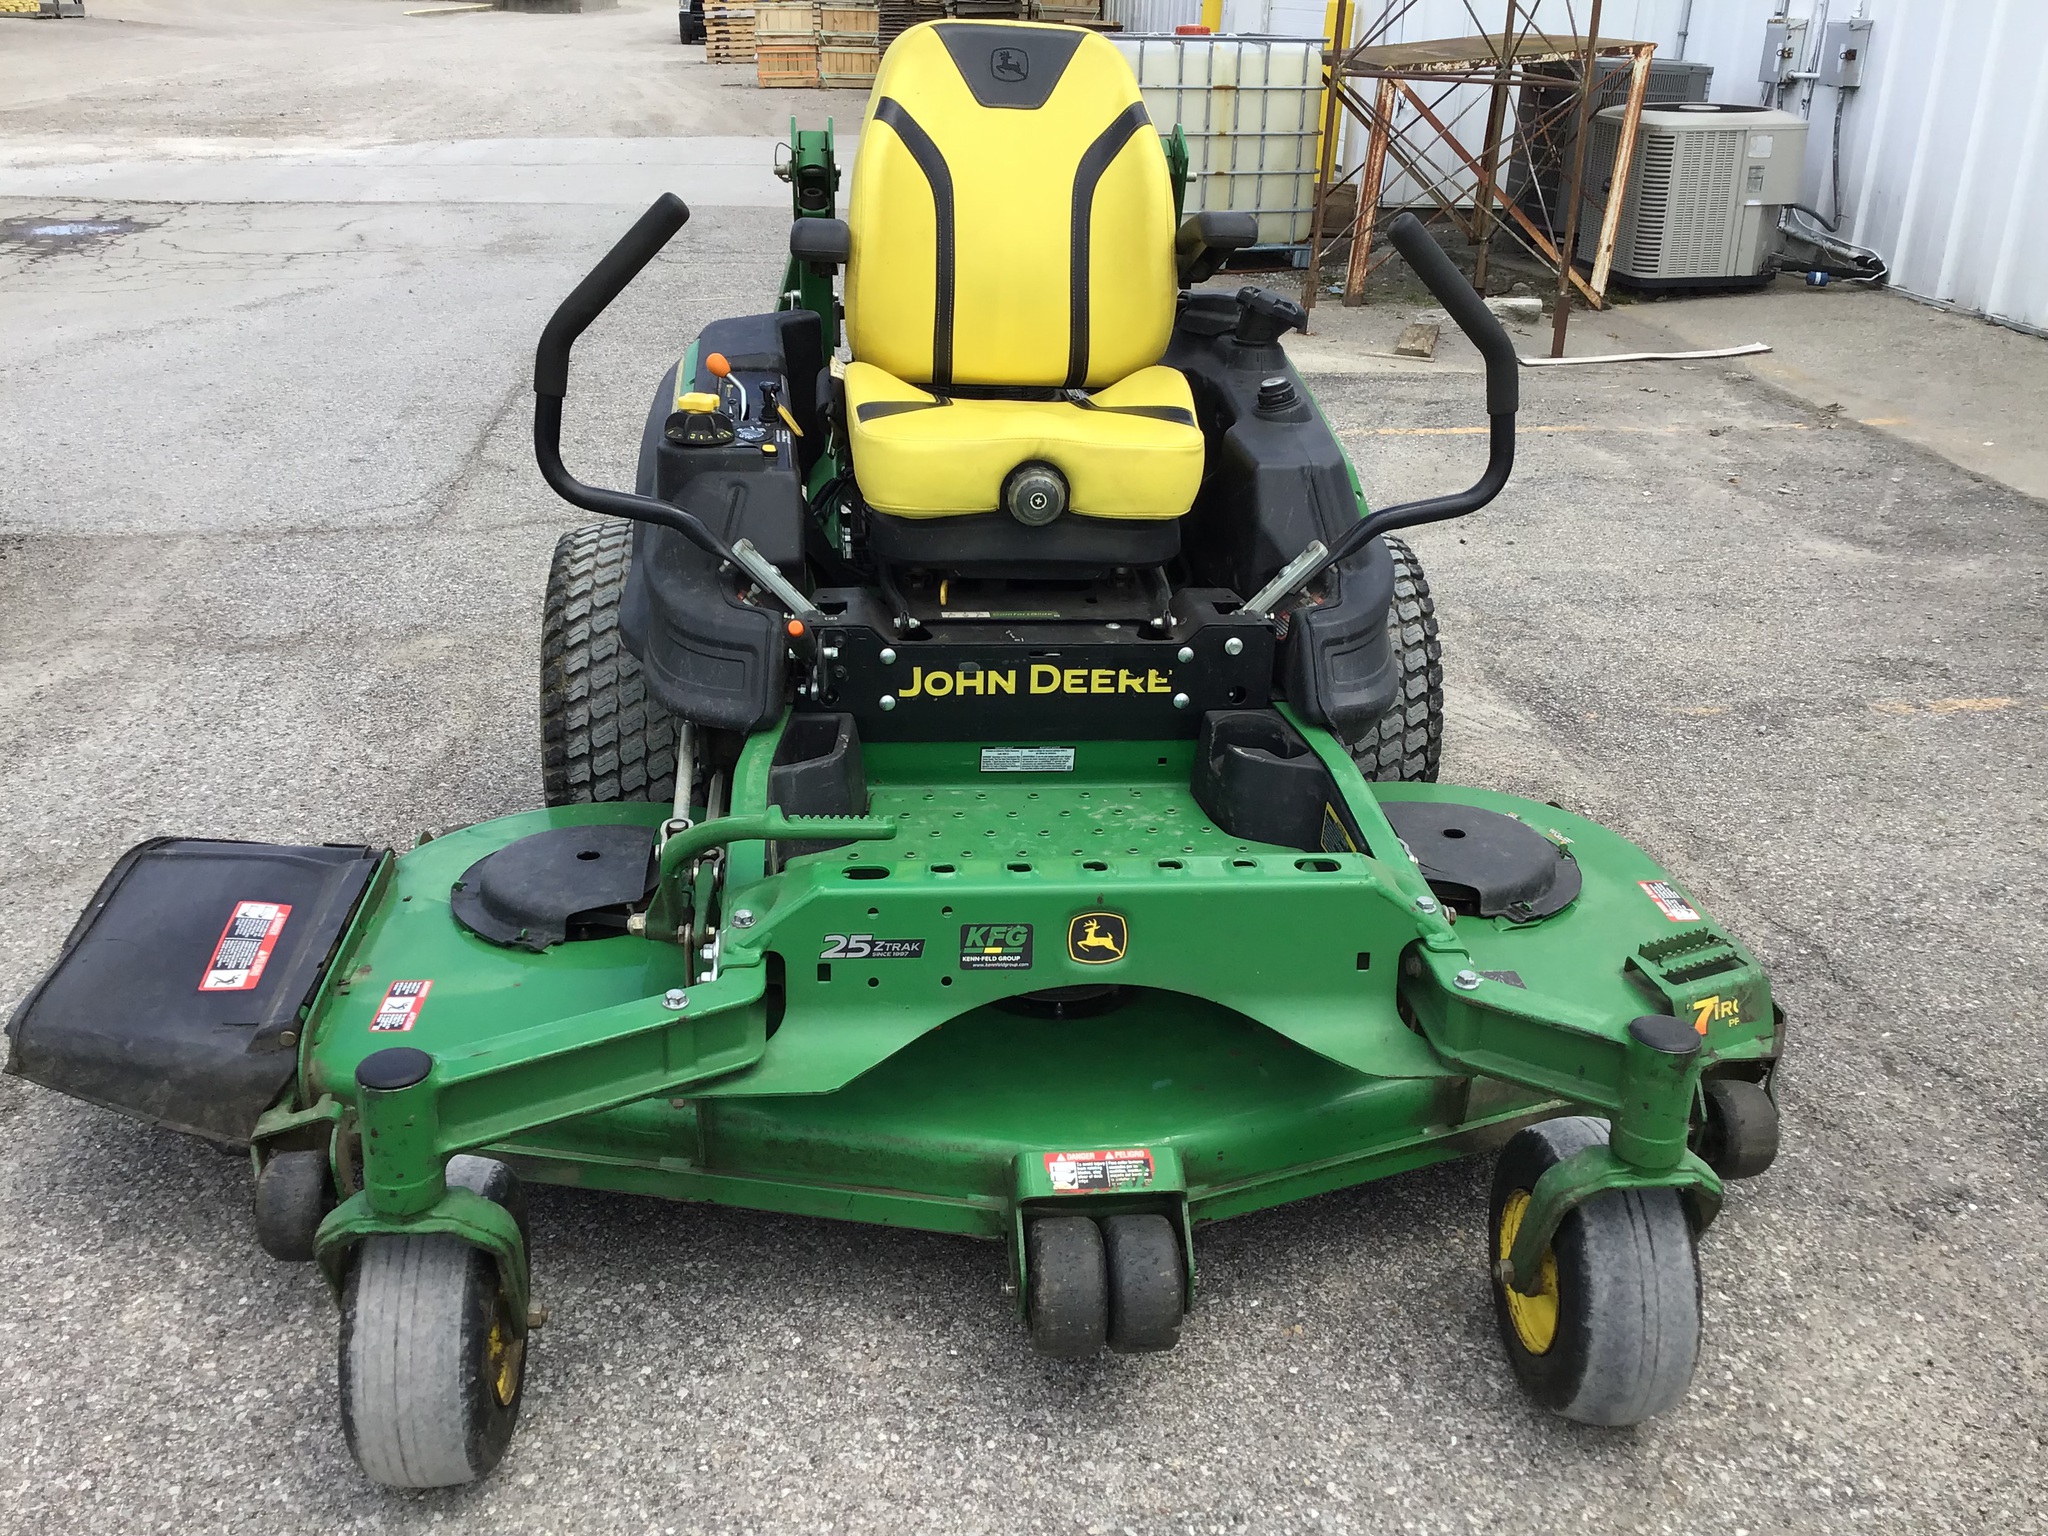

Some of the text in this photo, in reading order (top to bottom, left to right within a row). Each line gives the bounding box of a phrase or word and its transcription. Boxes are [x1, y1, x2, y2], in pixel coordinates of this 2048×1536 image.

[898, 664, 1173, 698] JOHN DEERE
[964, 925, 1029, 947] KFG
[819, 934, 873, 959] 25
[873, 941, 921, 952] ZTRAK
[1066, 1152, 1095, 1160] DANGER
[1114, 1150, 1145, 1159] PELIGRO
